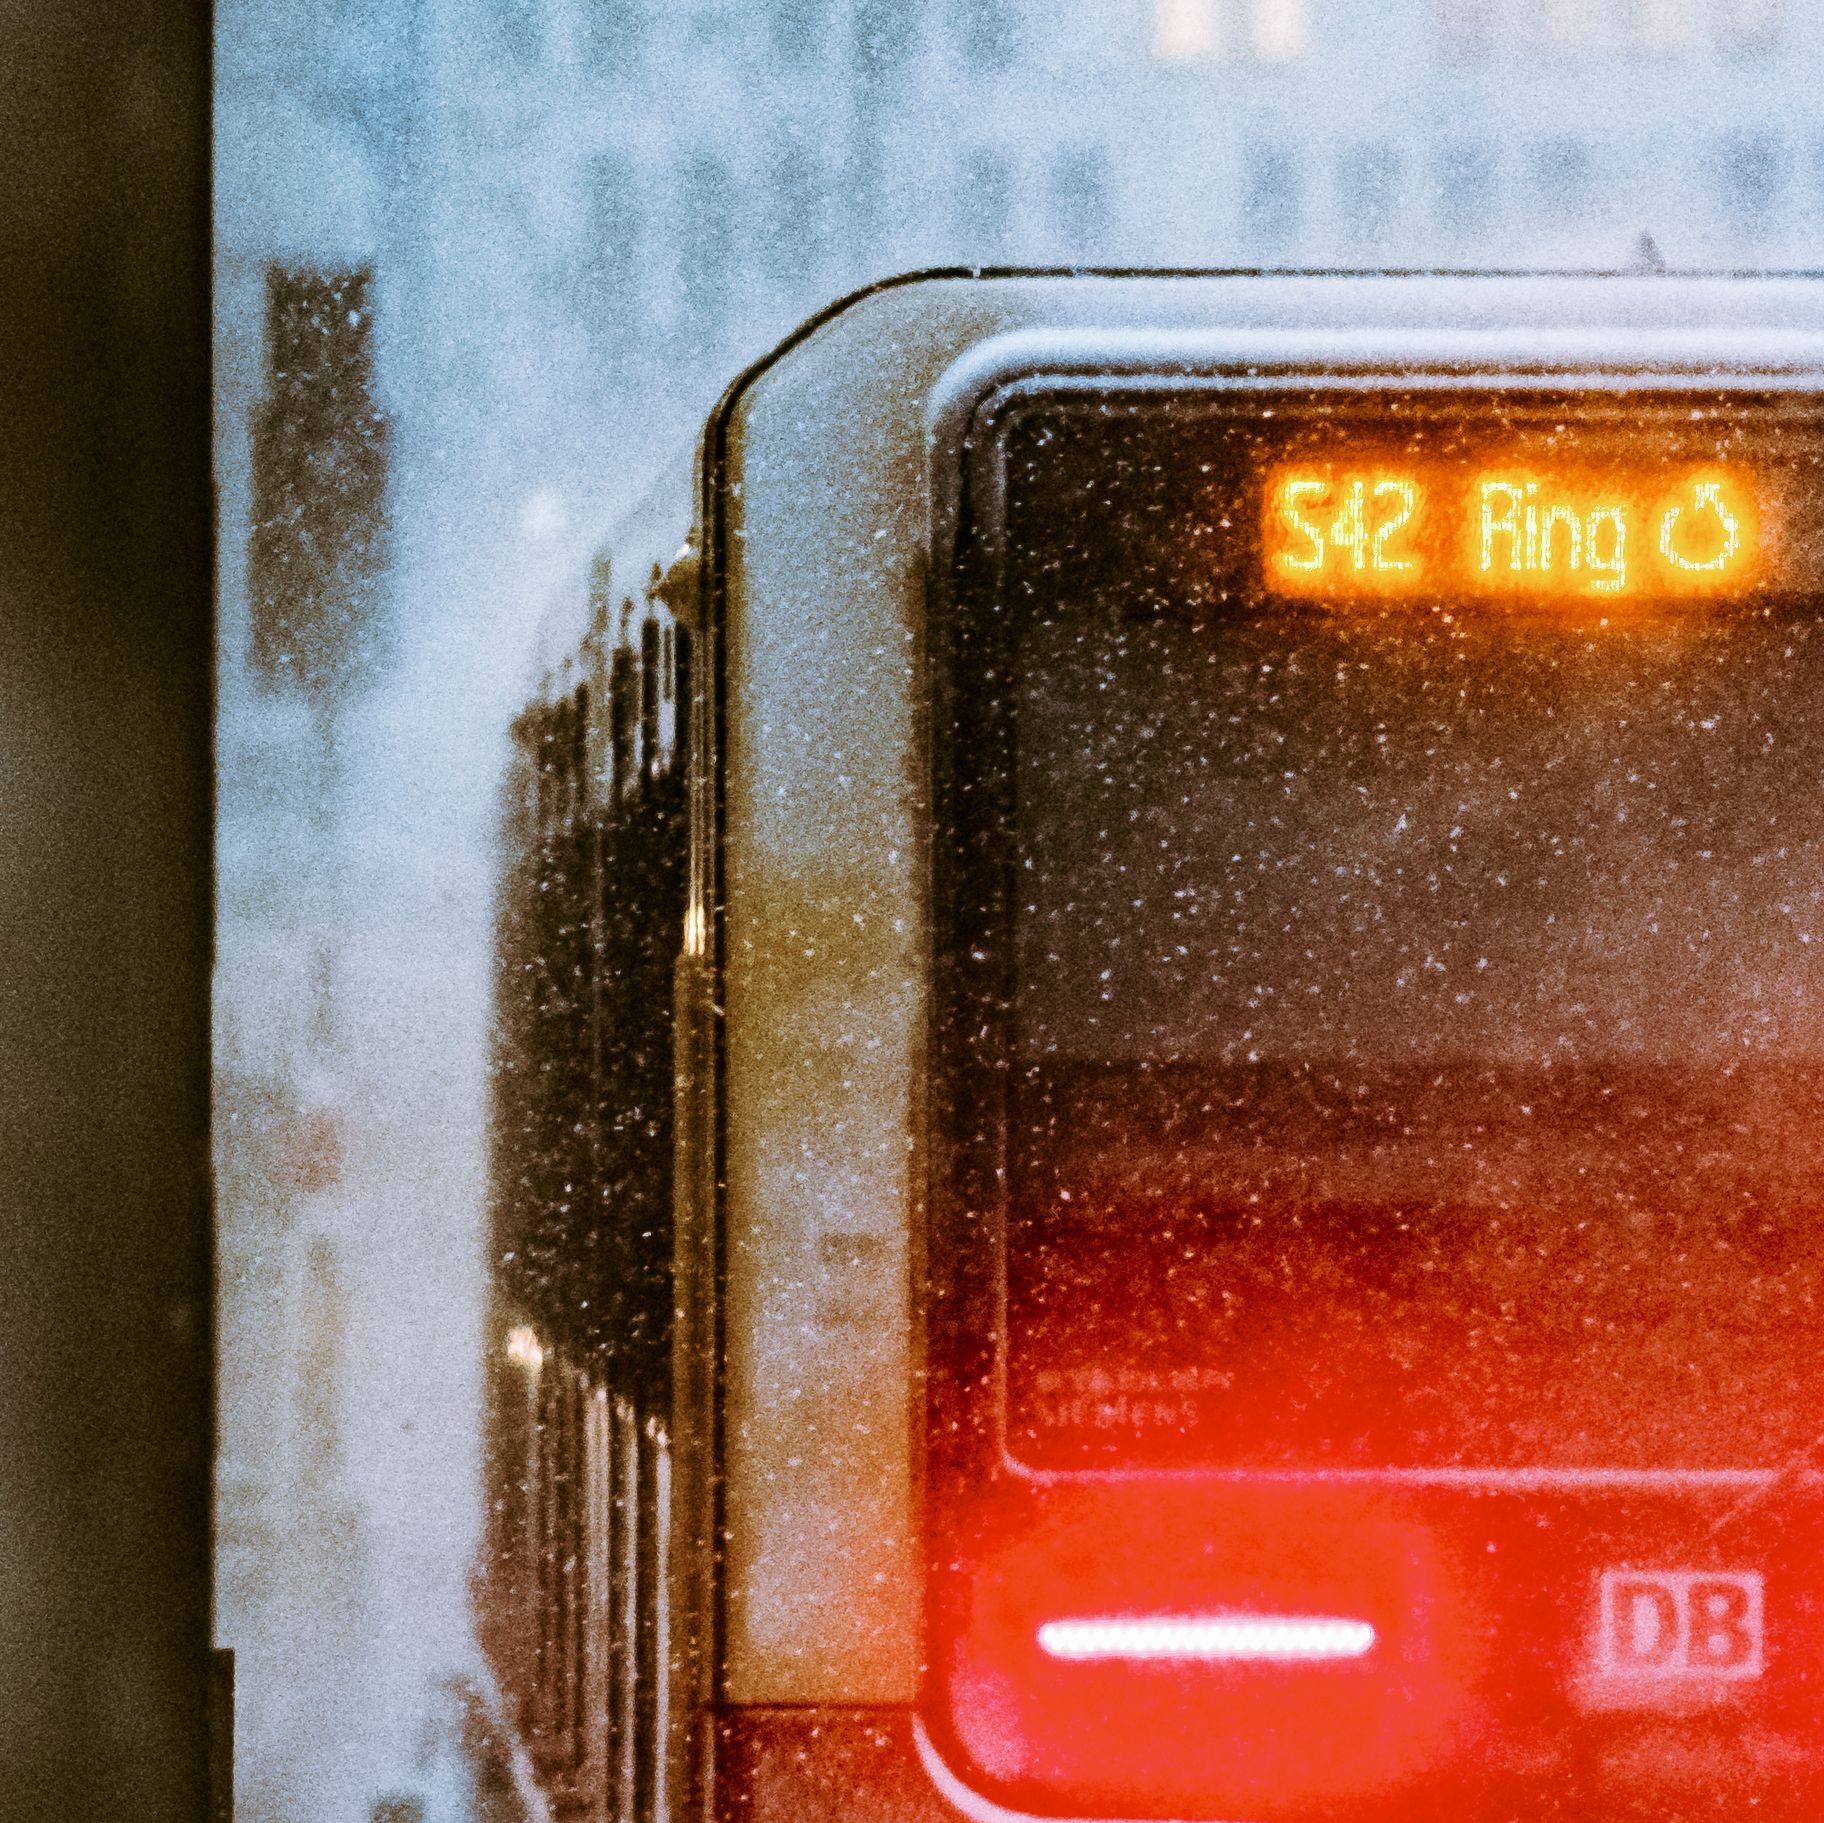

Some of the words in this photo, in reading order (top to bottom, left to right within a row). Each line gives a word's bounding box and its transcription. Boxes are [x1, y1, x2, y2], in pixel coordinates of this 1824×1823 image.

[1282, 478, 1417, 572] S42
[1478, 478, 1627, 592] Ring
[1611, 1578, 1755, 1671] DB
